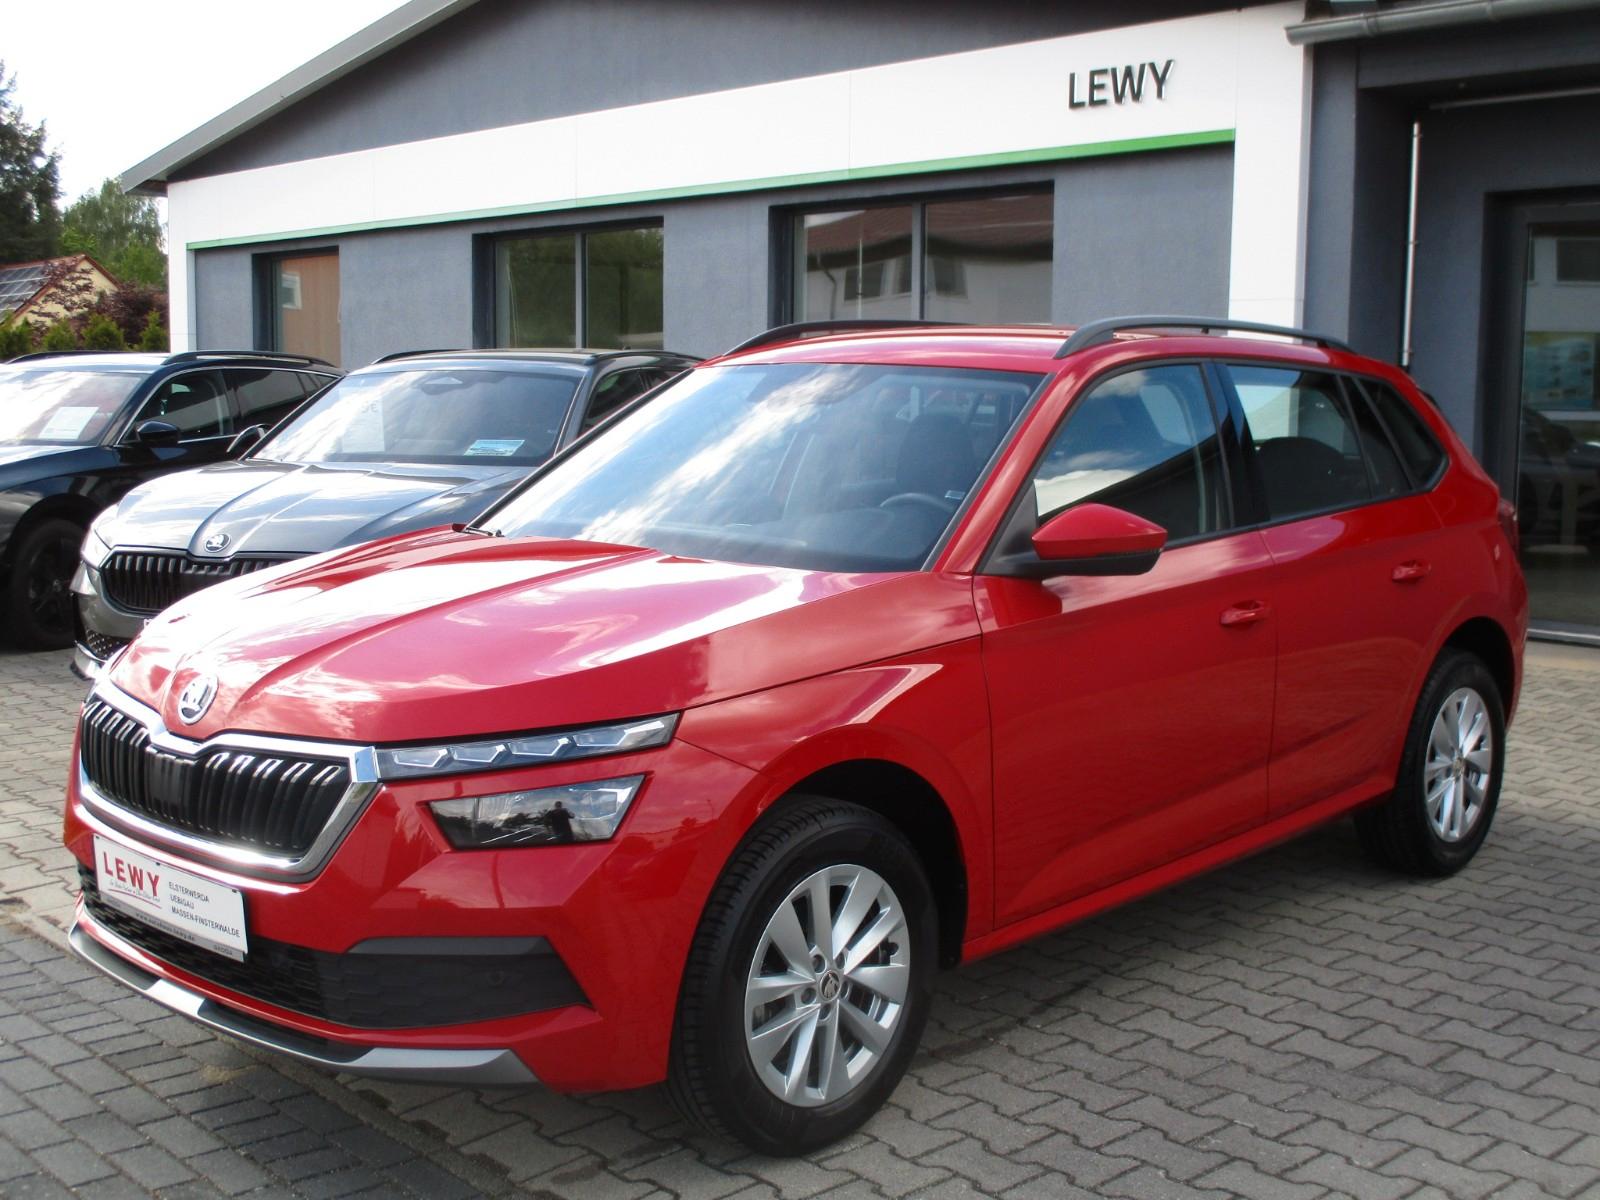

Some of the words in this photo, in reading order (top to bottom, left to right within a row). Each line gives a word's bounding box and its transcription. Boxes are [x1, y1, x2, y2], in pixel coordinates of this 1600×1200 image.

[1069, 59, 1174, 109] LEWY
[103, 851, 160, 897] LEWY
[168, 881, 210, 903] ELSTERWERDA
[171, 905, 241, 938] MASSEN-FINSTERWALDE
